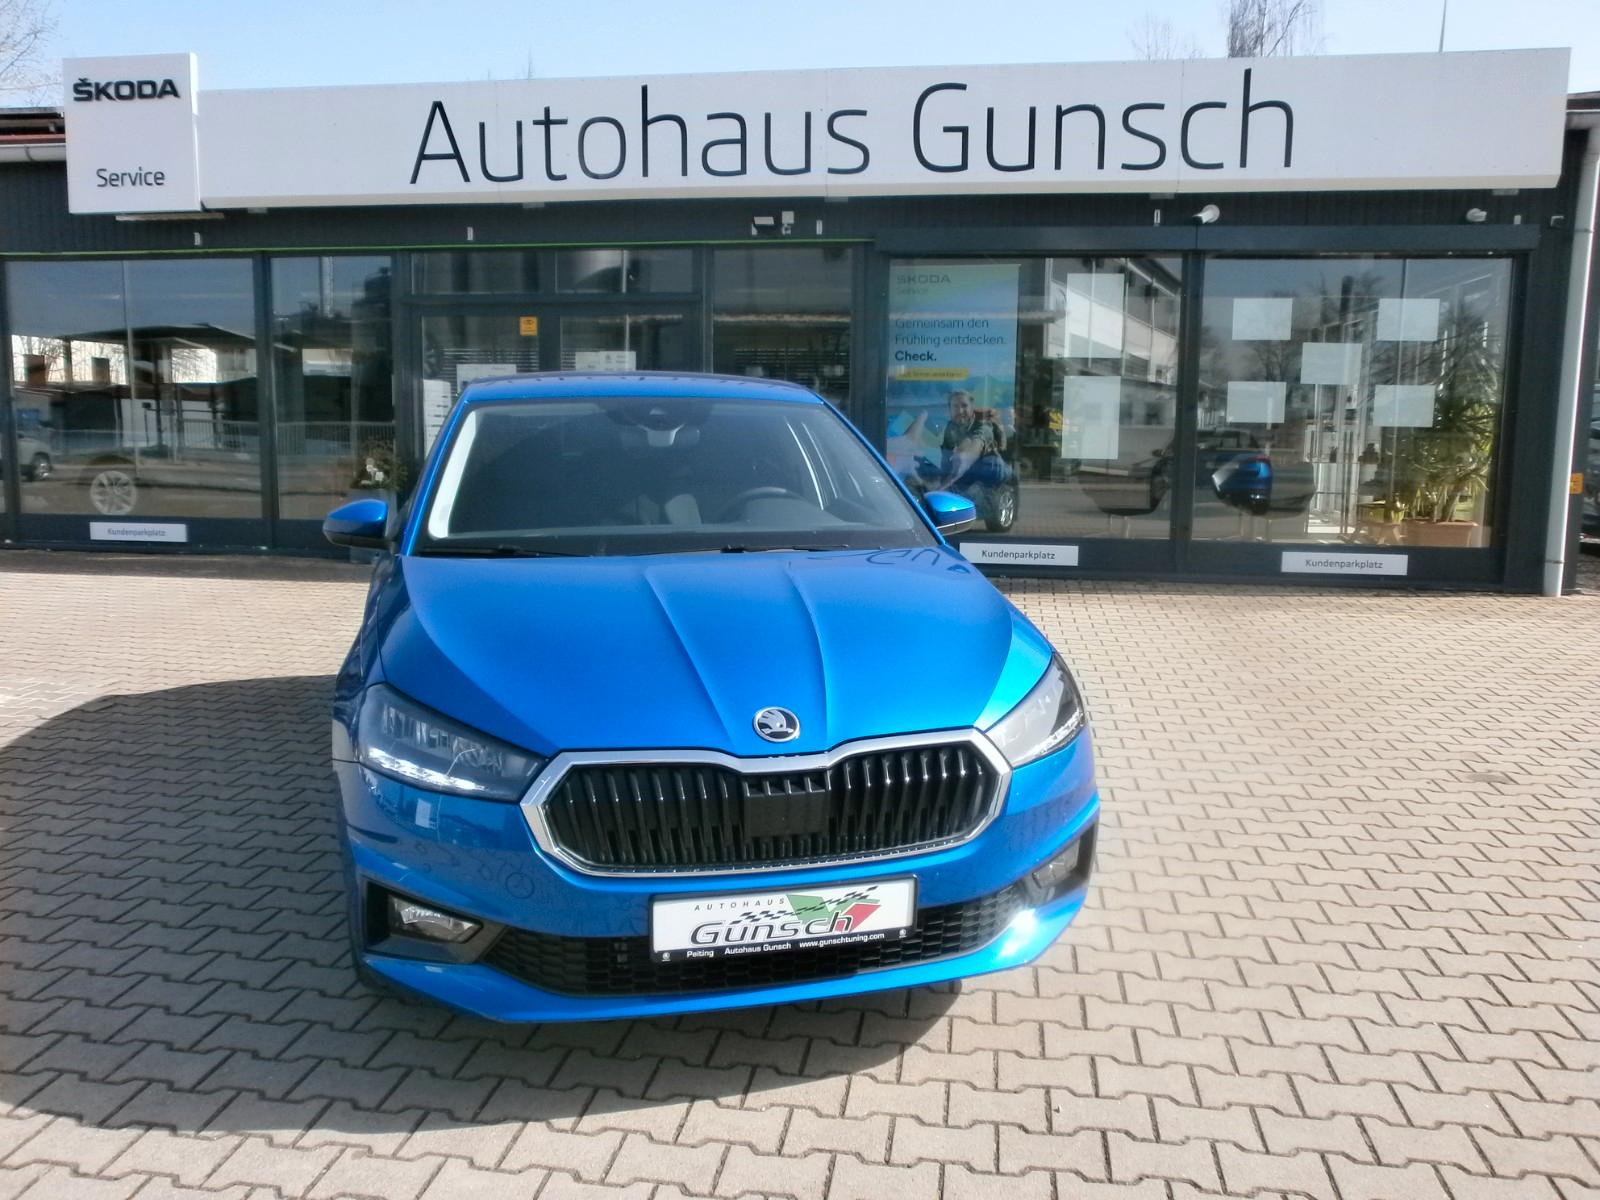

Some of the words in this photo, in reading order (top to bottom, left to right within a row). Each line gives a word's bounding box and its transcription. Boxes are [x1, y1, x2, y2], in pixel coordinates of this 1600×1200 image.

[73, 78, 181, 102] ŠKODA
[410, 85, 870, 185] Autohaus
[912, 68, 1294, 173] Gunsch
[96, 167, 165, 188] Service
[895, 318, 964, 329] Gemeinsam
[967, 317, 989, 329] den
[943, 334, 1007, 345] entdecken.
[894, 350, 937, 362] Check.
[107, 527, 166, 538] Kundenparkplatz
[981, 548, 1056, 561] Kundenparkplatz
[1305, 558, 1383, 570] Kundenparkplatz
[694, 897, 785, 911] AUTOHAUS
[690, 910, 854, 946] Gunsch
[687, 948, 714, 959] Peiting
[724, 944, 762, 956] Autohaus
[763, 941, 792, 952] Gunsch
[799, 931, 885, 948] www.gunschtuning.com
